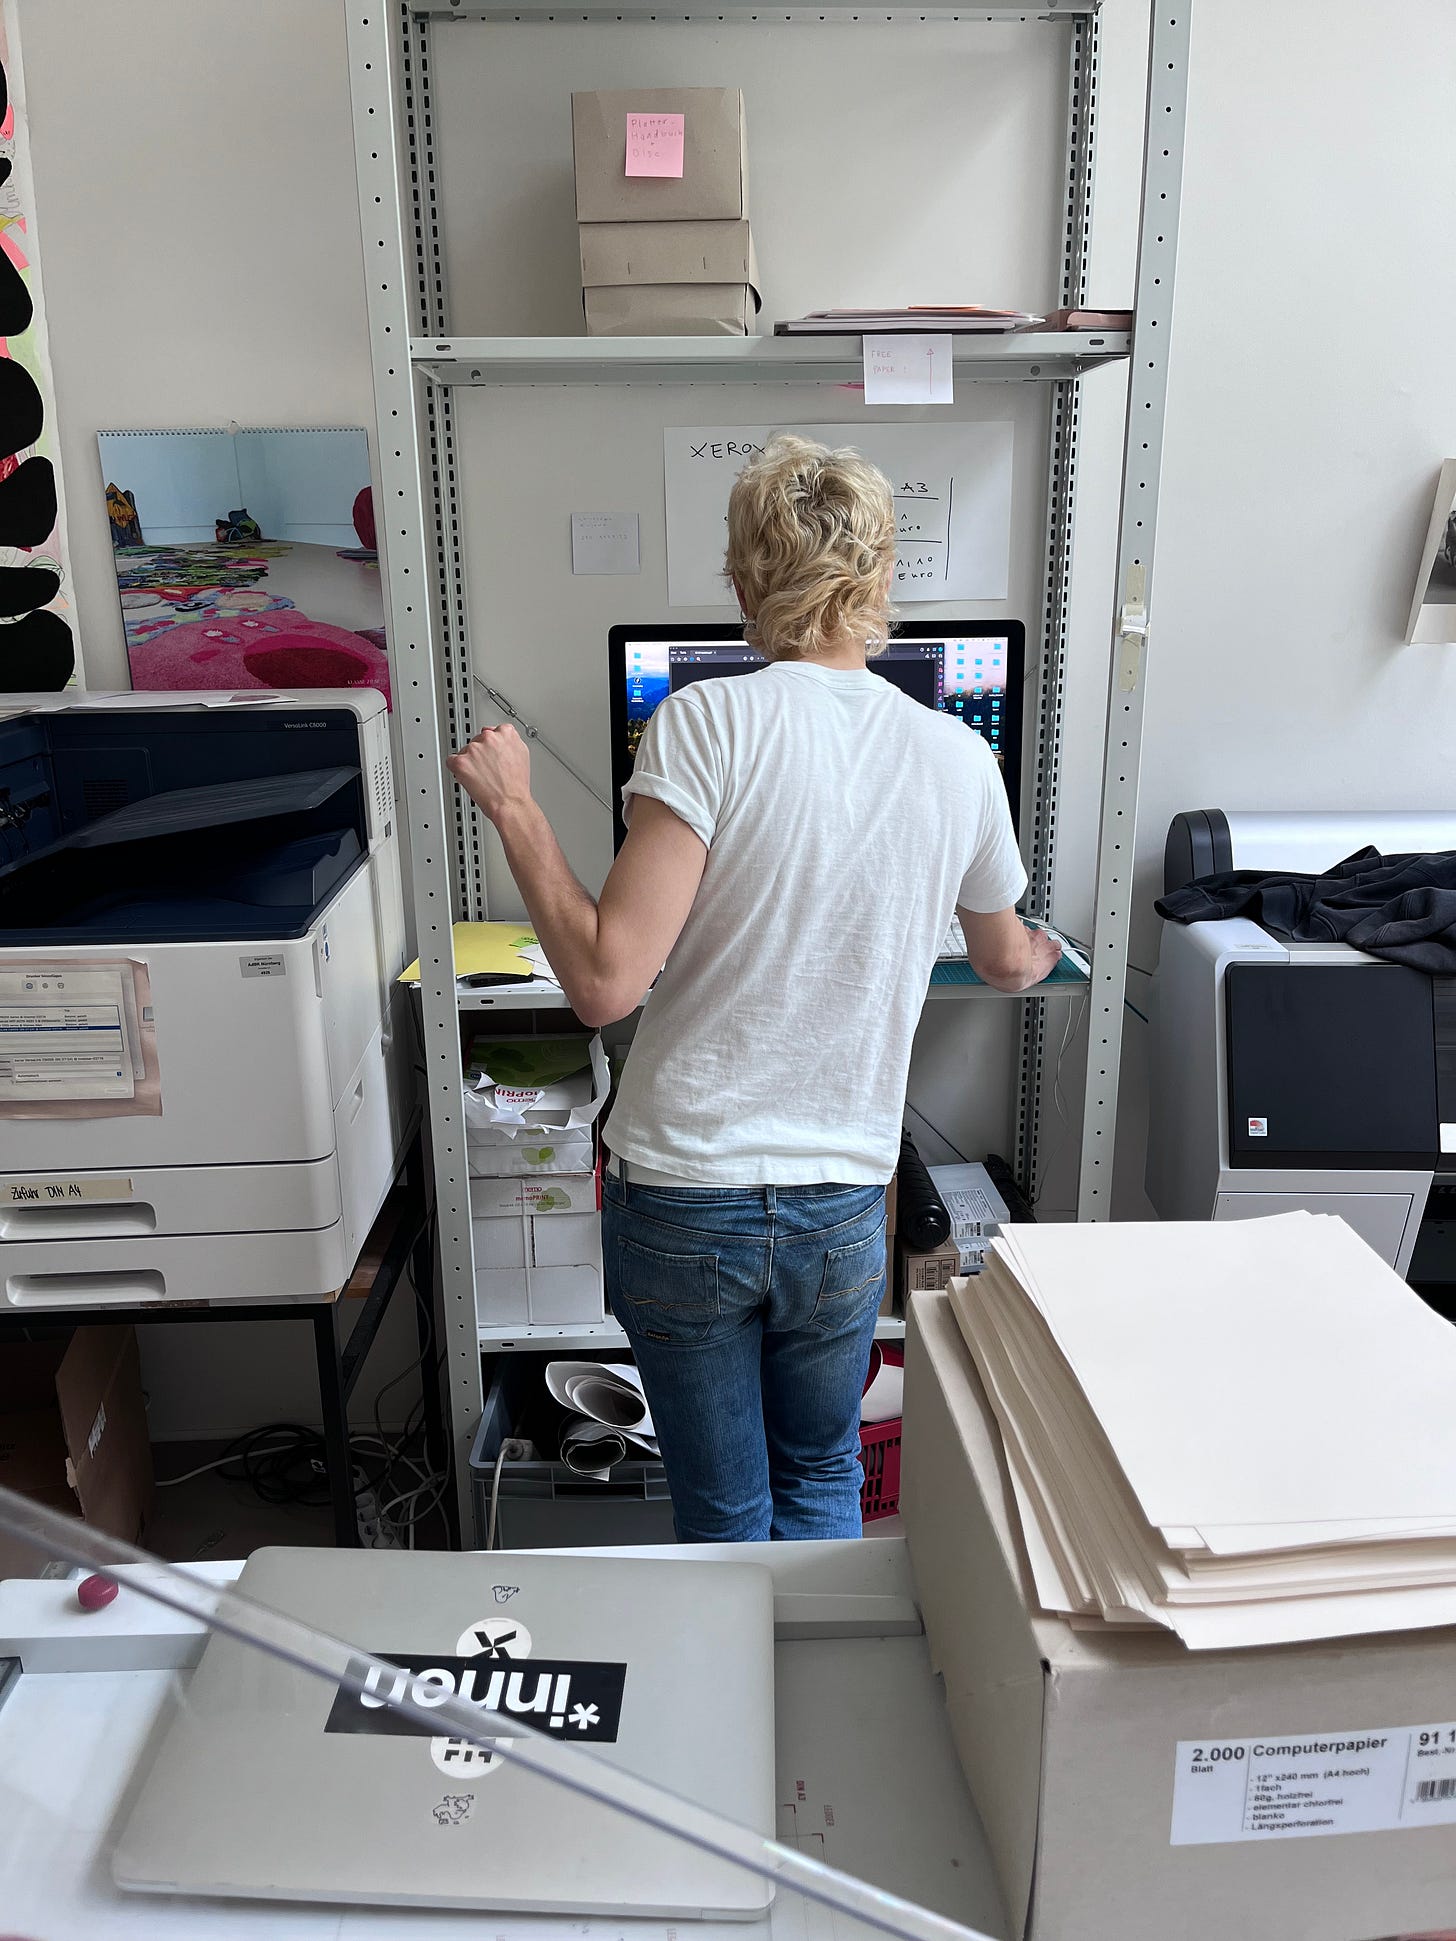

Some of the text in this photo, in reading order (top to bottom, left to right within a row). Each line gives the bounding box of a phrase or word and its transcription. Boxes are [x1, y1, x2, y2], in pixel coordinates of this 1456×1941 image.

[872, 349, 893, 358] FREE
[901, 482, 929, 493] A3
[44, 1185, 65, 1198] DIN
[68, 1184, 82, 1197] A4
[1192, 1747, 1245, 1762] 2.000
[1253, 1737, 1388, 1757] Computerpapier
[1419, 1732, 1439, 1746] 91
[1191, 1765, 1214, 1773] Blatt
